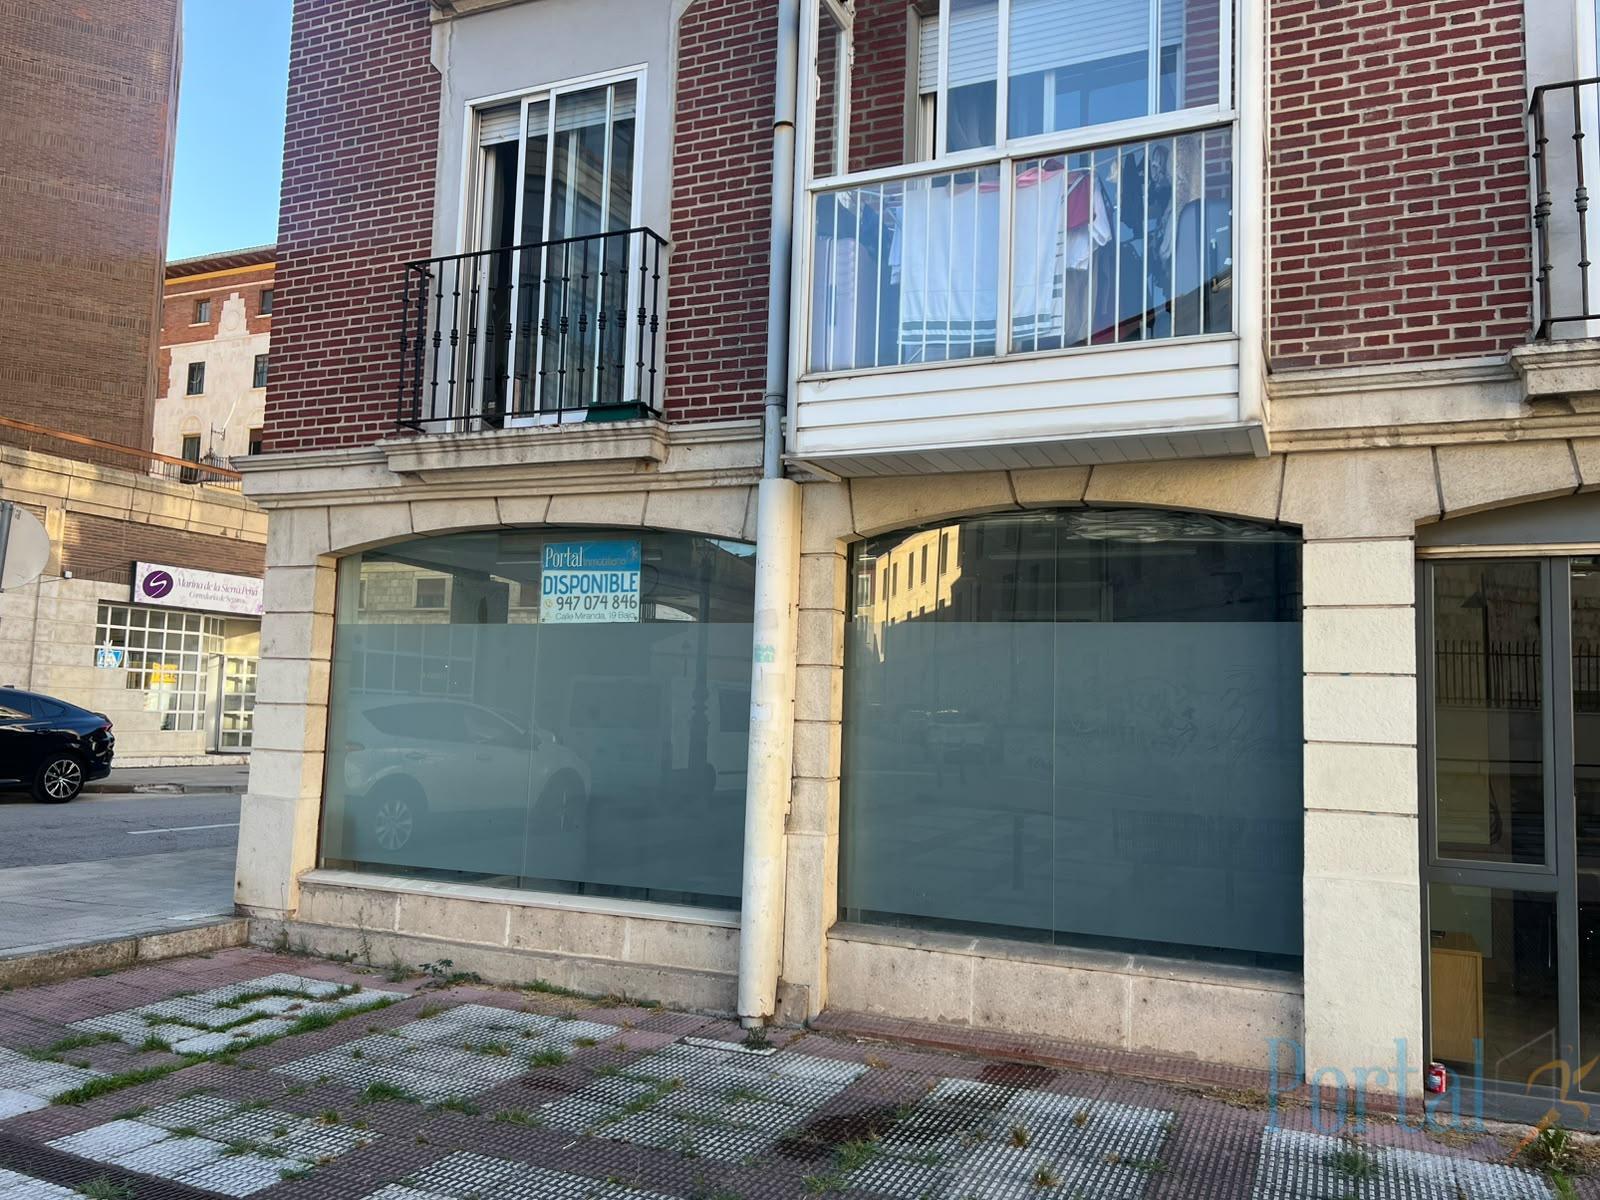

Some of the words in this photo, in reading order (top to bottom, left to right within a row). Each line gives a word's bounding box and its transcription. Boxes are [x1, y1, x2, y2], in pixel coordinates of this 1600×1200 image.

[545, 546, 583, 567] Portal
[204, 581, 211, 590] de
[213, 582, 220, 592] la
[220, 584, 241, 595] Sierra
[544, 573, 638, 595] DISPONIBLE
[556, 596, 580, 611] 947
[584, 595, 608, 610] 074
[612, 594, 638, 610] 846
[555, 612, 574, 620] Calle
[609, 611, 616, 619] 19
[618, 611, 635, 621] Bajo
